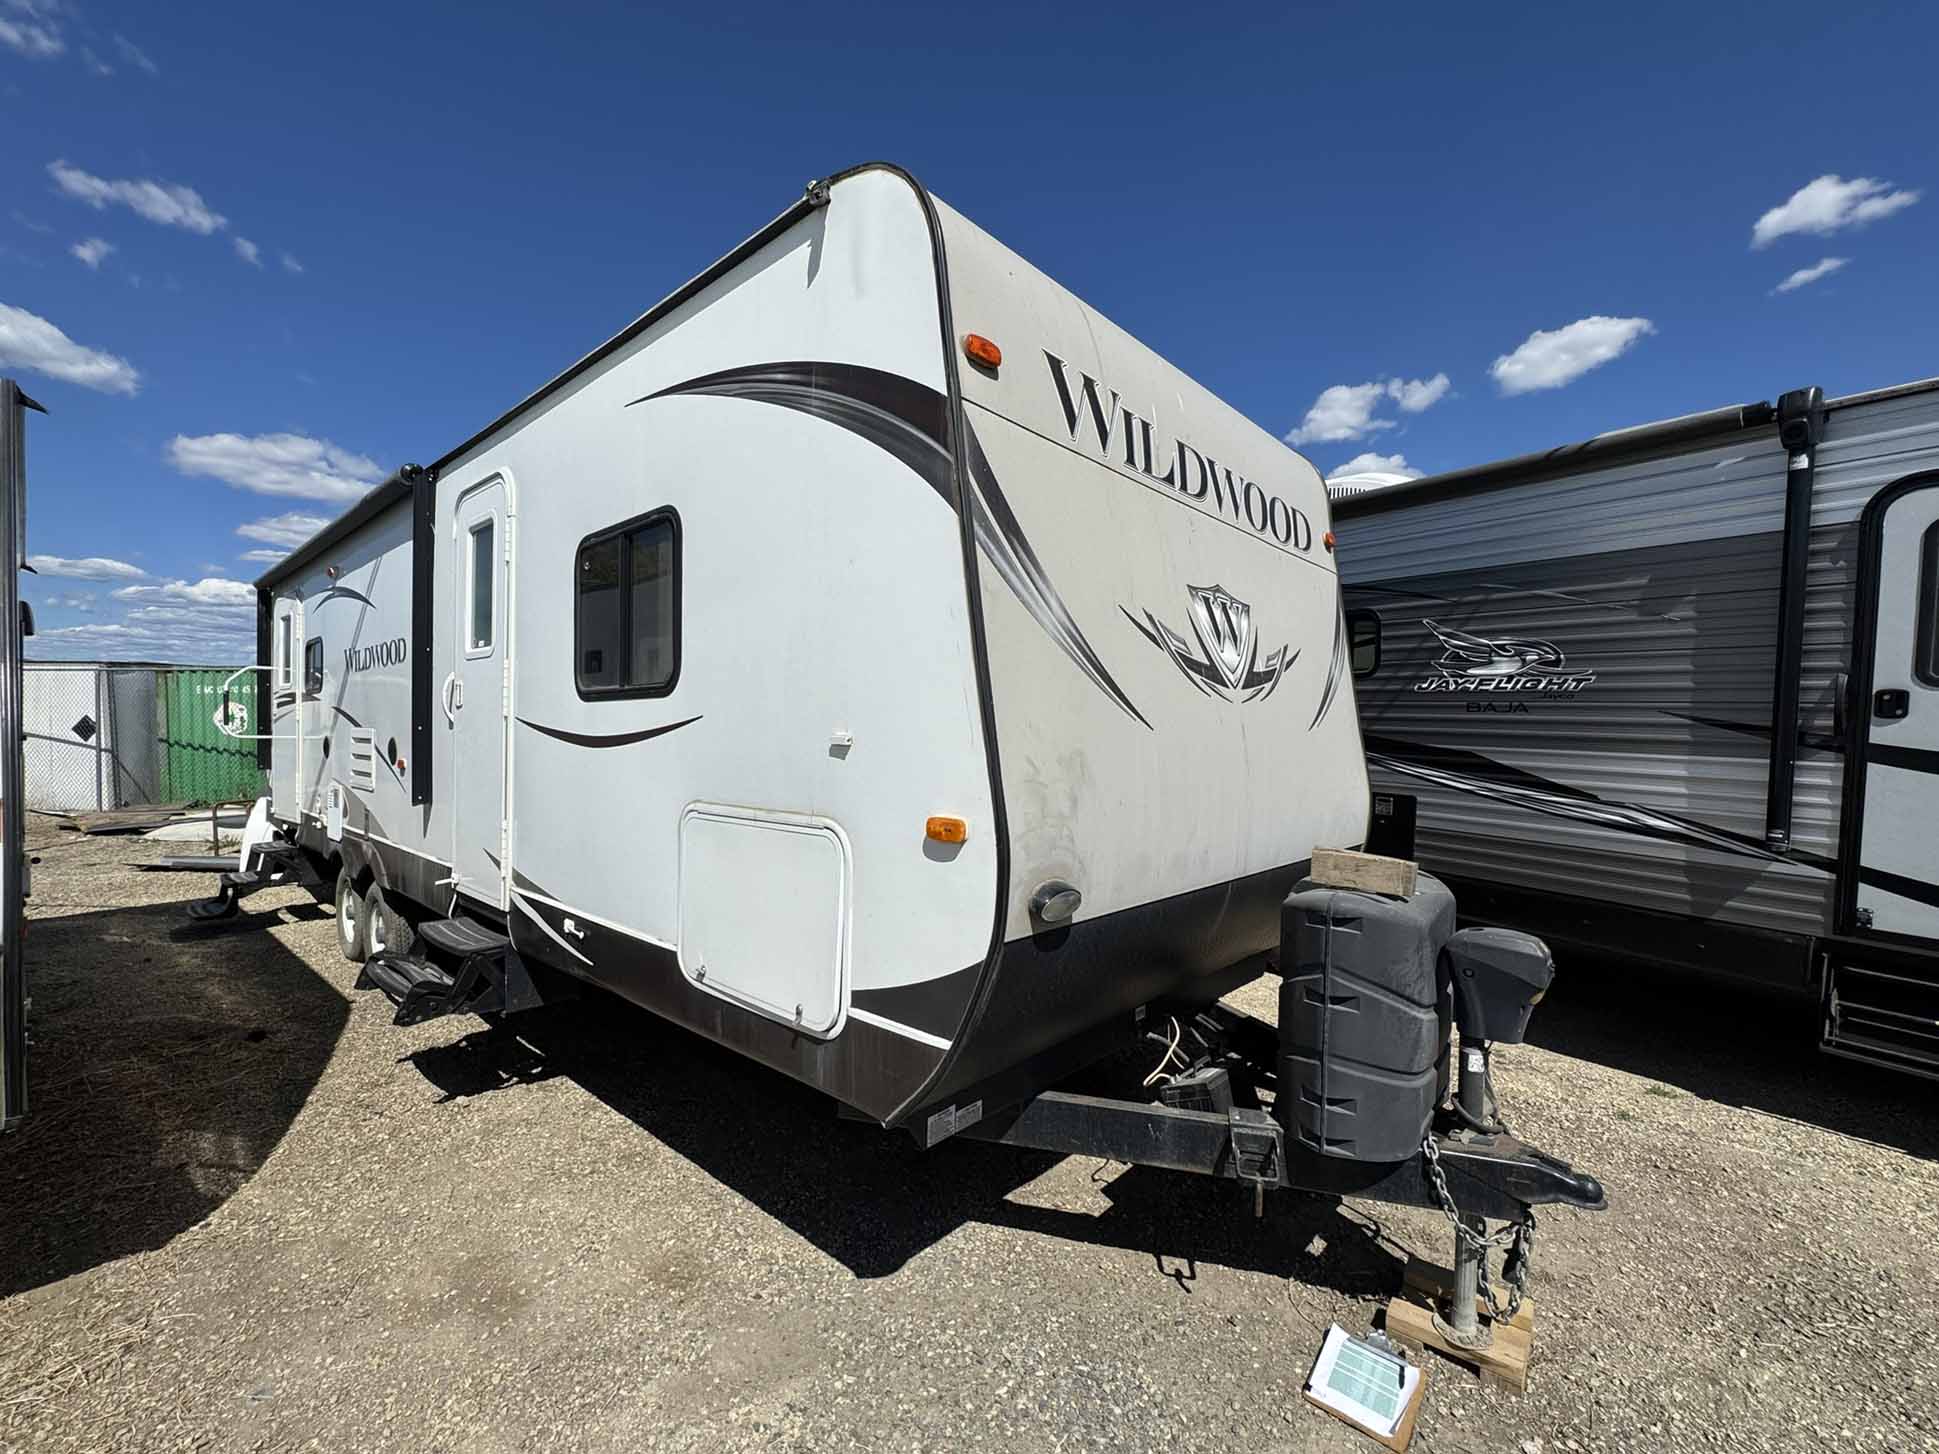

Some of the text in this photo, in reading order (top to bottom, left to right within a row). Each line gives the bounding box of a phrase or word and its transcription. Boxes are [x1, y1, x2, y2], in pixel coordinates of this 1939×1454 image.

[1041, 348, 1311, 553] WILDWOOD
[1198, 589, 1243, 656] W
[344, 637, 407, 673] WILDWOOD
[1465, 702, 1529, 713] BAJA
